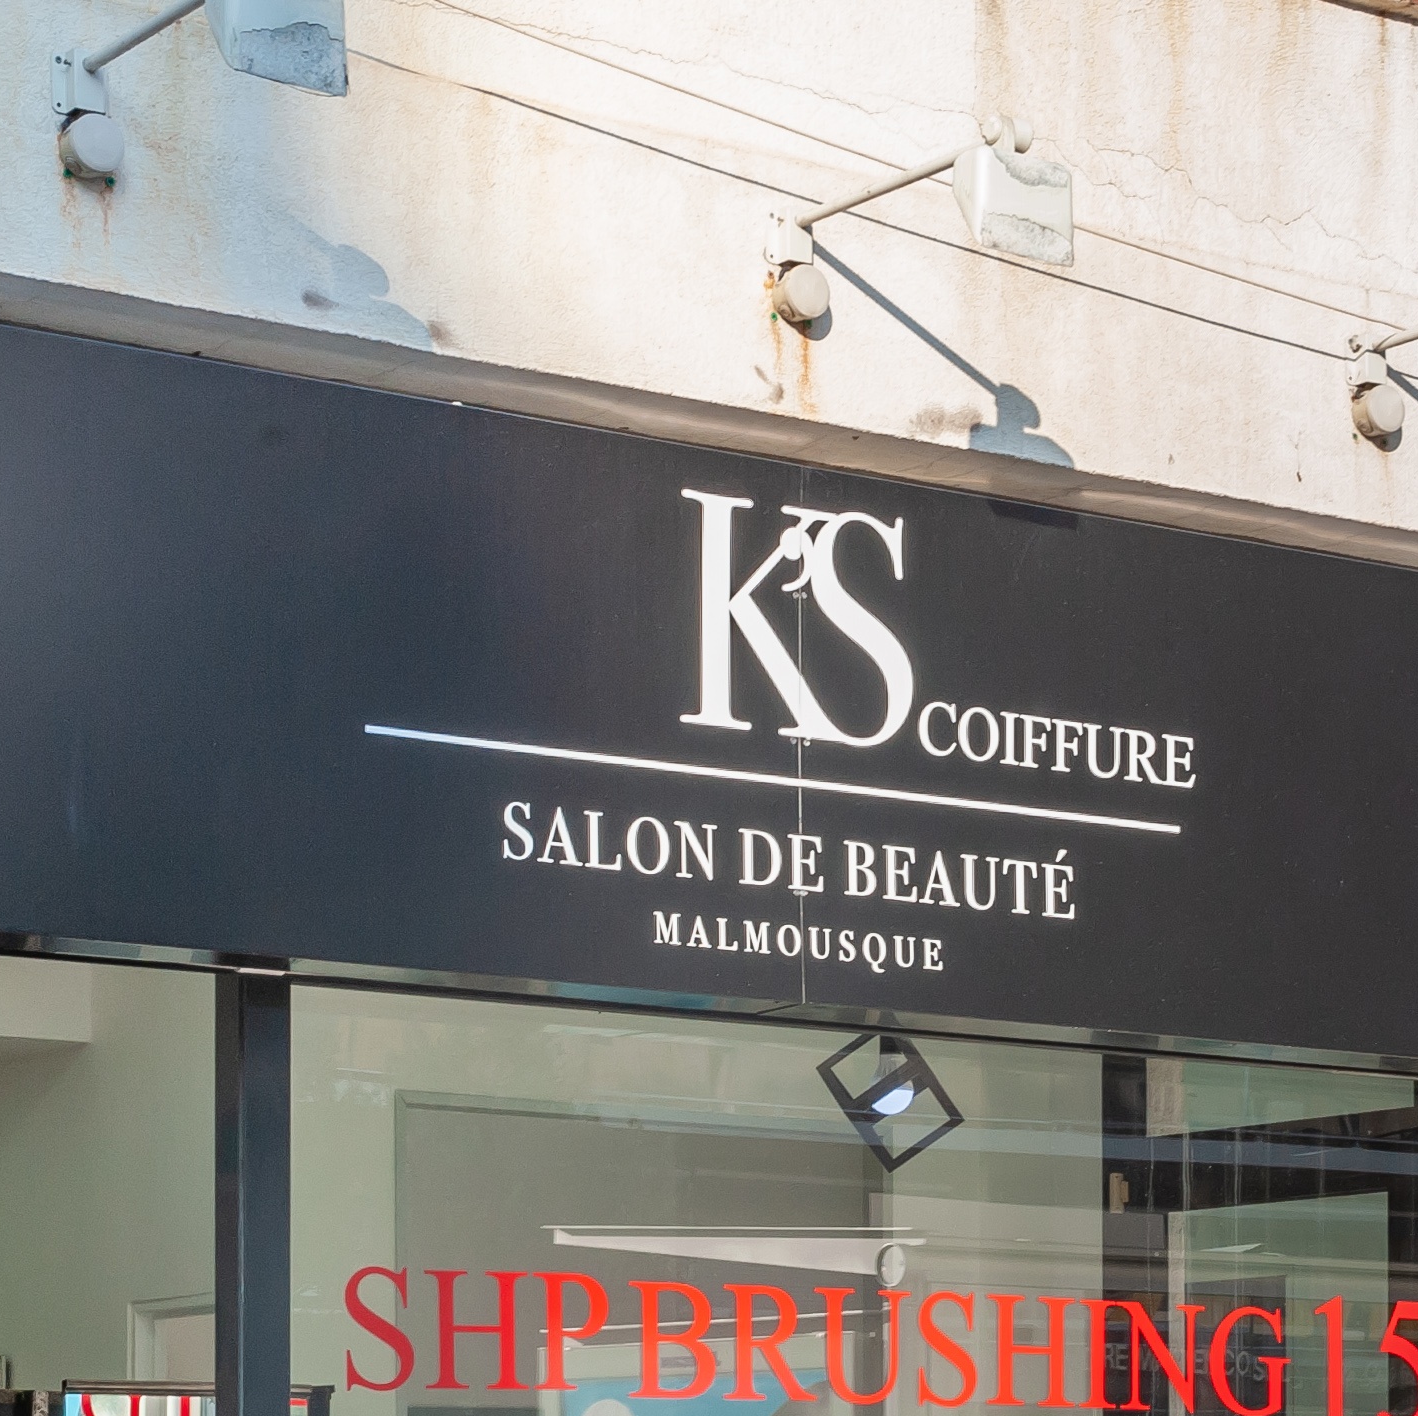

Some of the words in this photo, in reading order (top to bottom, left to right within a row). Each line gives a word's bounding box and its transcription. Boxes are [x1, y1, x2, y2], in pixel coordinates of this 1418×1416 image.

[918, 700, 1197, 790] COIFFURE
[502, 801, 717, 880] SALON
[738, 827, 825, 895] DE
[843, 840, 1076, 921] BEAUTÉ
[653, 911, 945, 974] MALMOUSQUE
[344, 1265, 609, 1394] SHP
